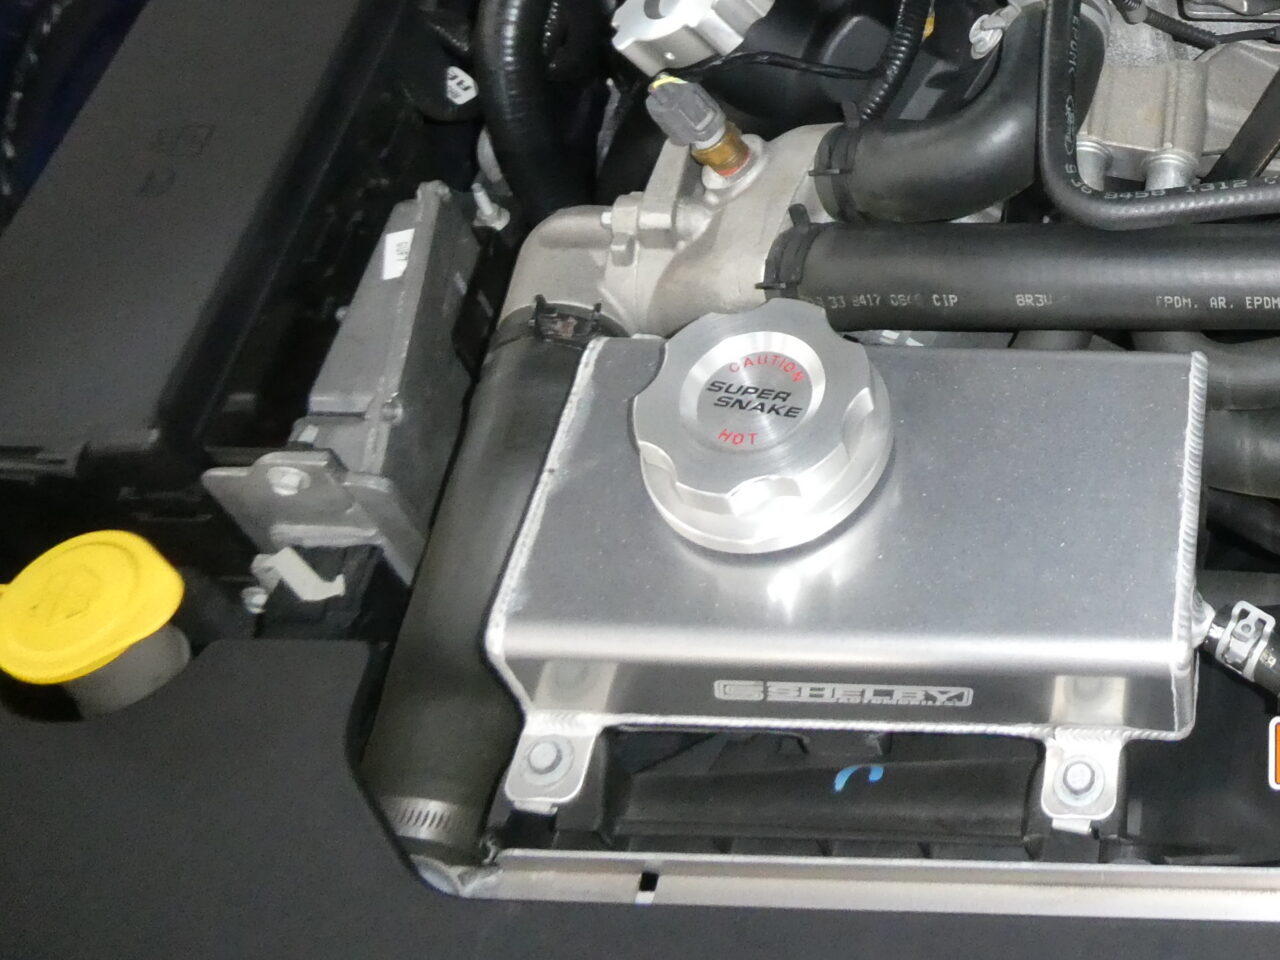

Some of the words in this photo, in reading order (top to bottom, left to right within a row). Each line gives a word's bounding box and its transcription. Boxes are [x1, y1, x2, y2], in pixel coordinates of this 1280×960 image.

[932, 294, 959, 307] CIP
[728, 354, 806, 383] CAUTION
[706, 380, 792, 402] SUPER
[713, 395, 803, 419] SNAKE
[717, 428, 758, 446] HOT
